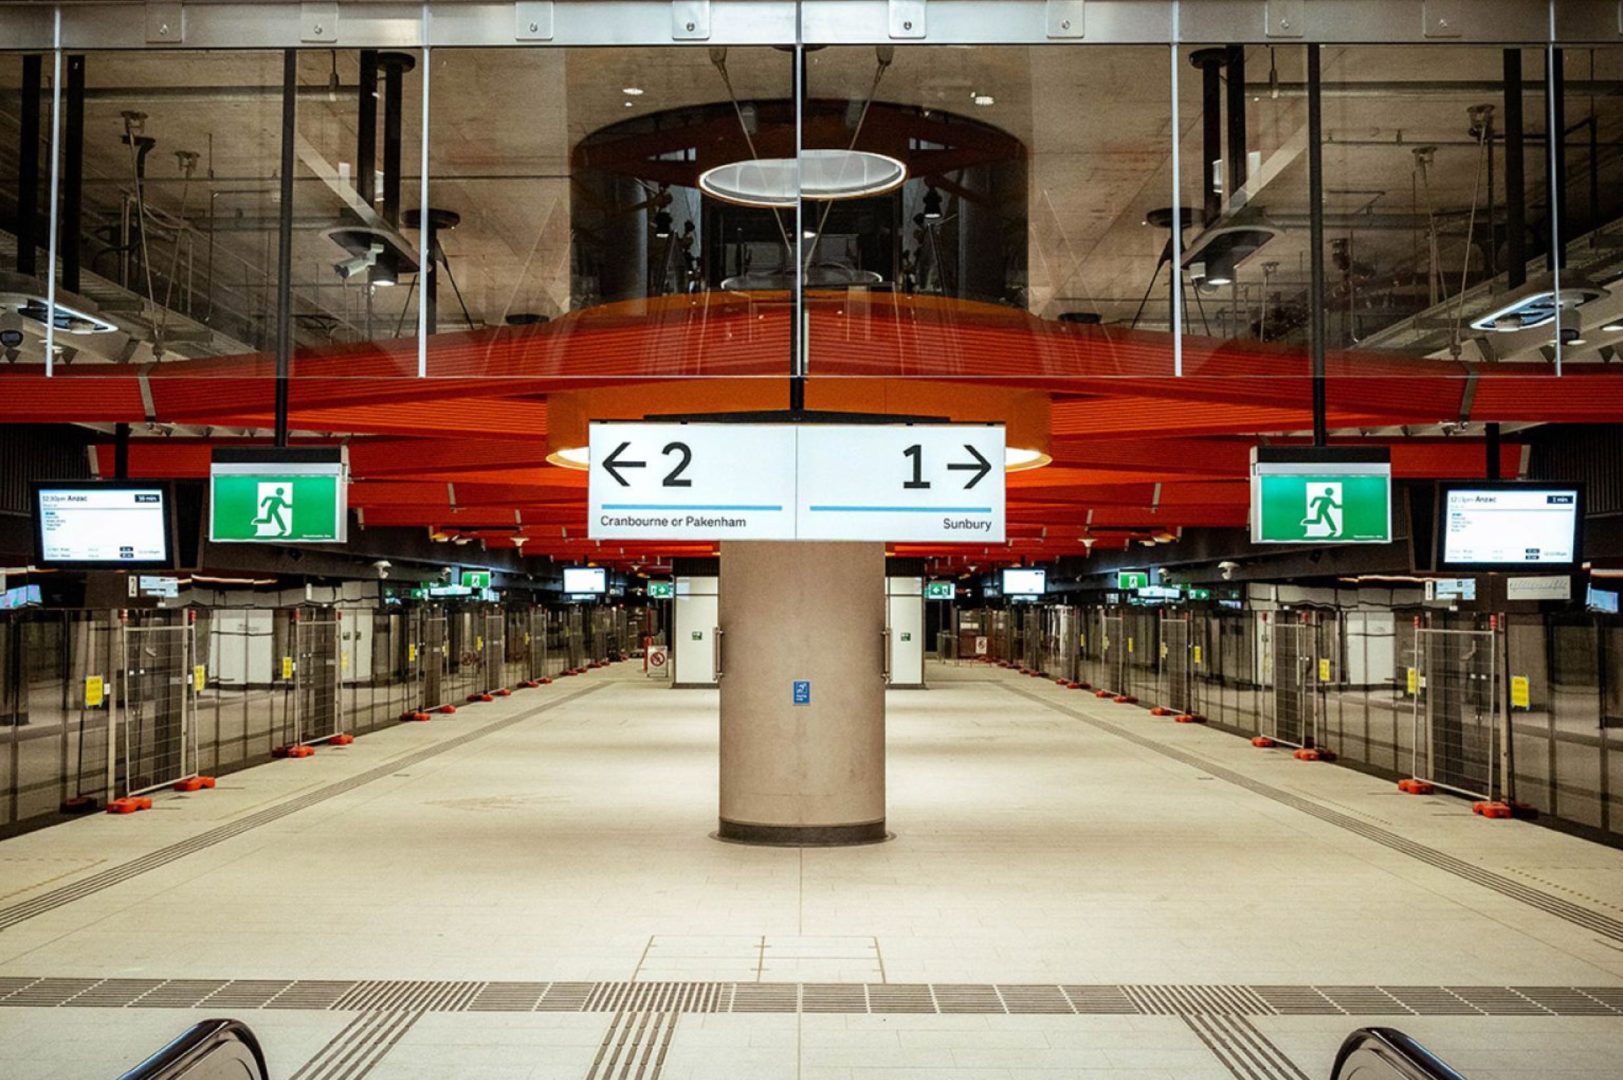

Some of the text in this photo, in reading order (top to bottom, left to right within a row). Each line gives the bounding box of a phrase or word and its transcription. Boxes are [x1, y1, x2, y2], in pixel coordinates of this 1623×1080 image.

[662, 442, 692, 487] 2
[903, 444, 931, 489] 1
[601, 515, 746, 528] Cranbourne or Pakenham
[943, 517, 992, 533] Sunbury
